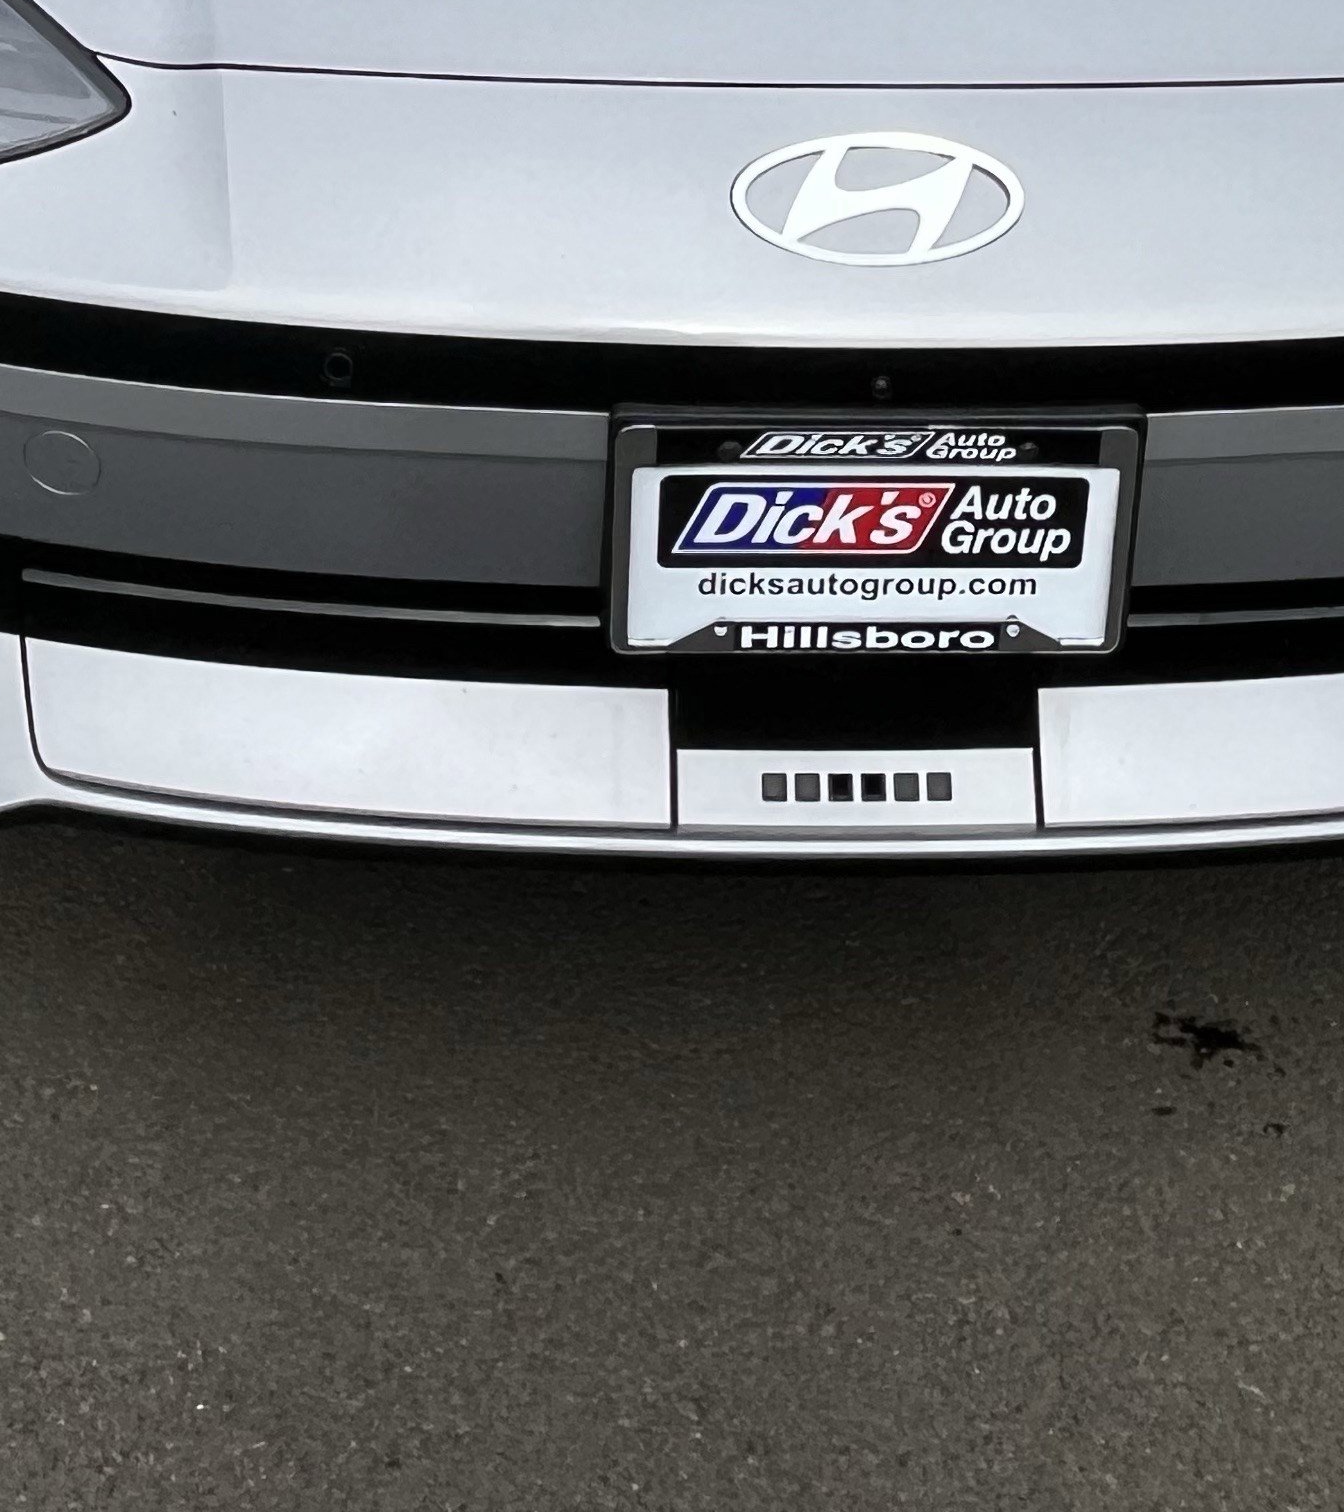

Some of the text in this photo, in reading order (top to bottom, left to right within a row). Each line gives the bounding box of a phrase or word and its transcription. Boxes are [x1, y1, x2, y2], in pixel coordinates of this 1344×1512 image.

[755, 433, 914, 456] Dick's
[925, 444, 1017, 462] Group
[940, 432, 1007, 447] Auto
[949, 485, 1058, 521] Auto
[692, 489, 922, 545] Dick's
[940, 521, 1072, 562] Group
[697, 571, 1038, 601] dicksautogroup.com
[739, 625, 995, 650] Hillsboro
